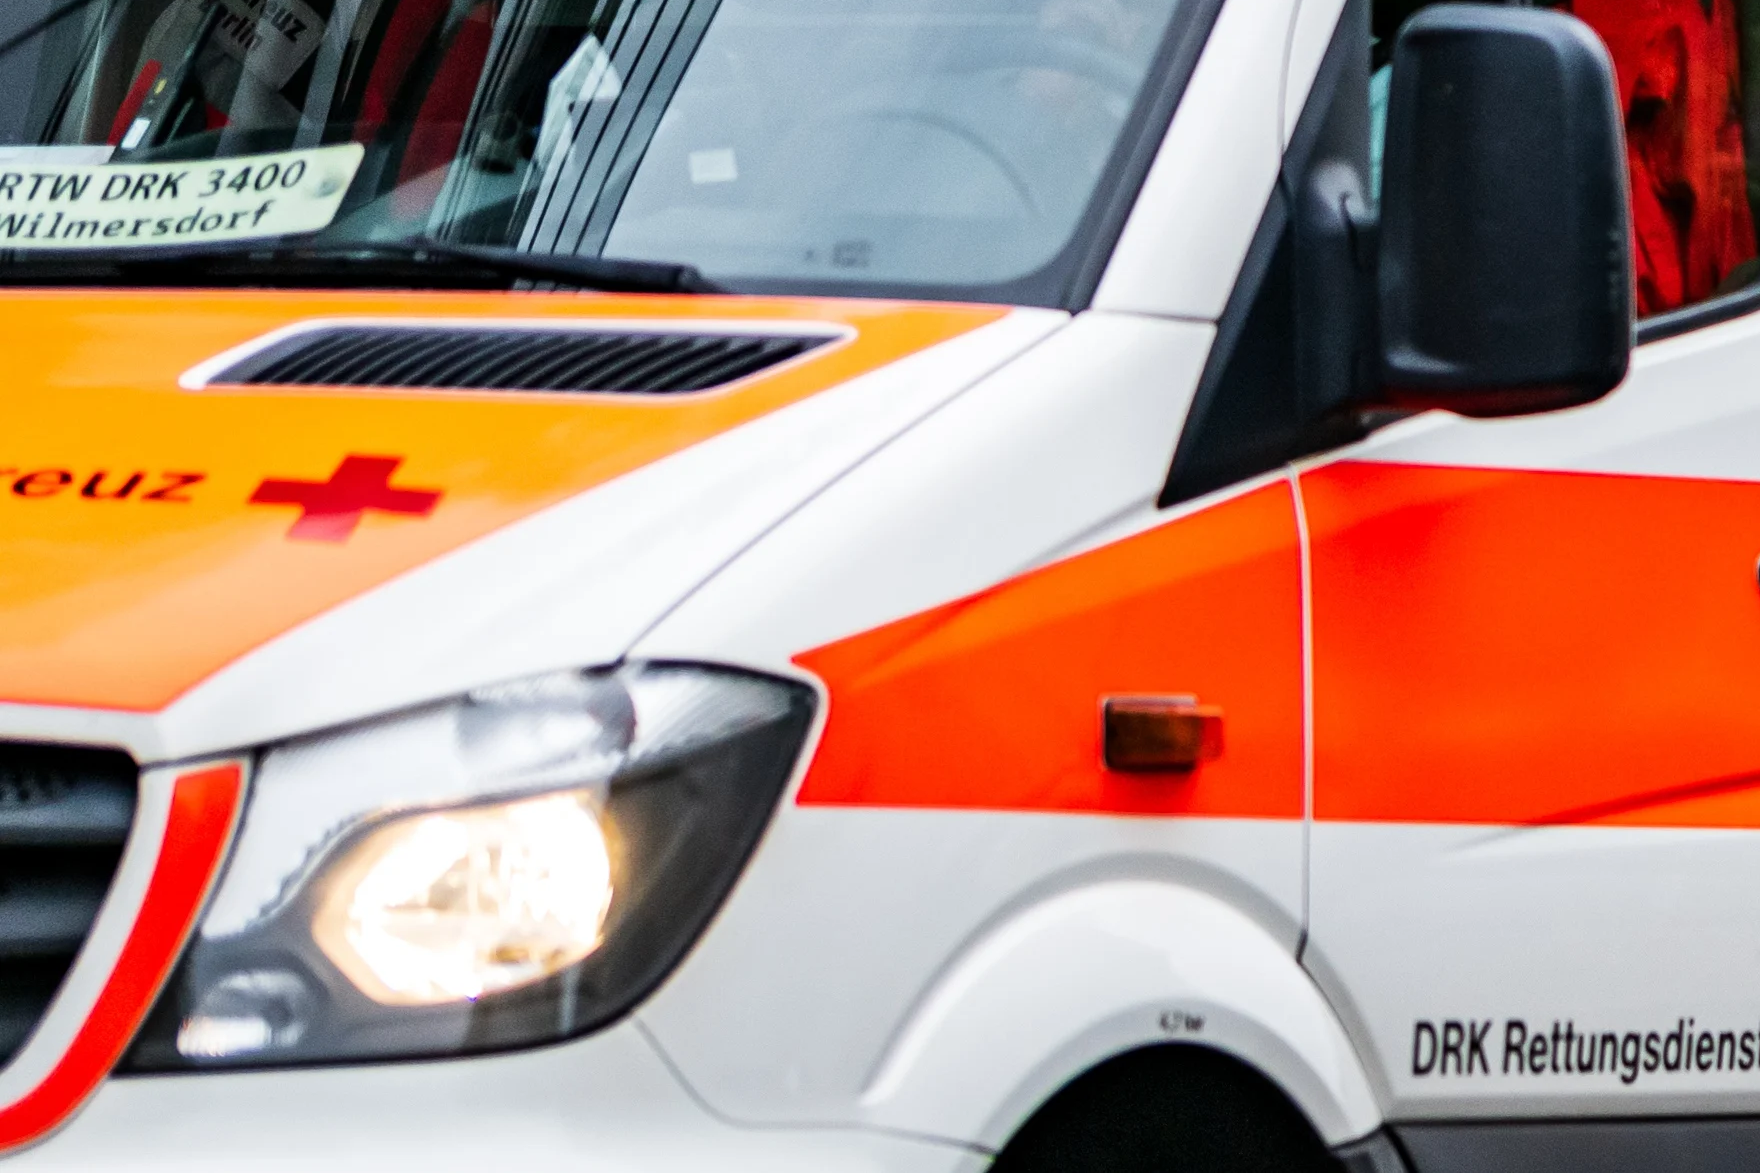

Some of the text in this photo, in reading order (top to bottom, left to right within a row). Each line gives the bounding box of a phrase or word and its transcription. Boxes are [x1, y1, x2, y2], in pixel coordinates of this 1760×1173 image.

[0, 159, 307, 201] RTW DRK 3400
[0, 468, 208, 502] euz
[1412, 1020, 1492, 1076] DRK
